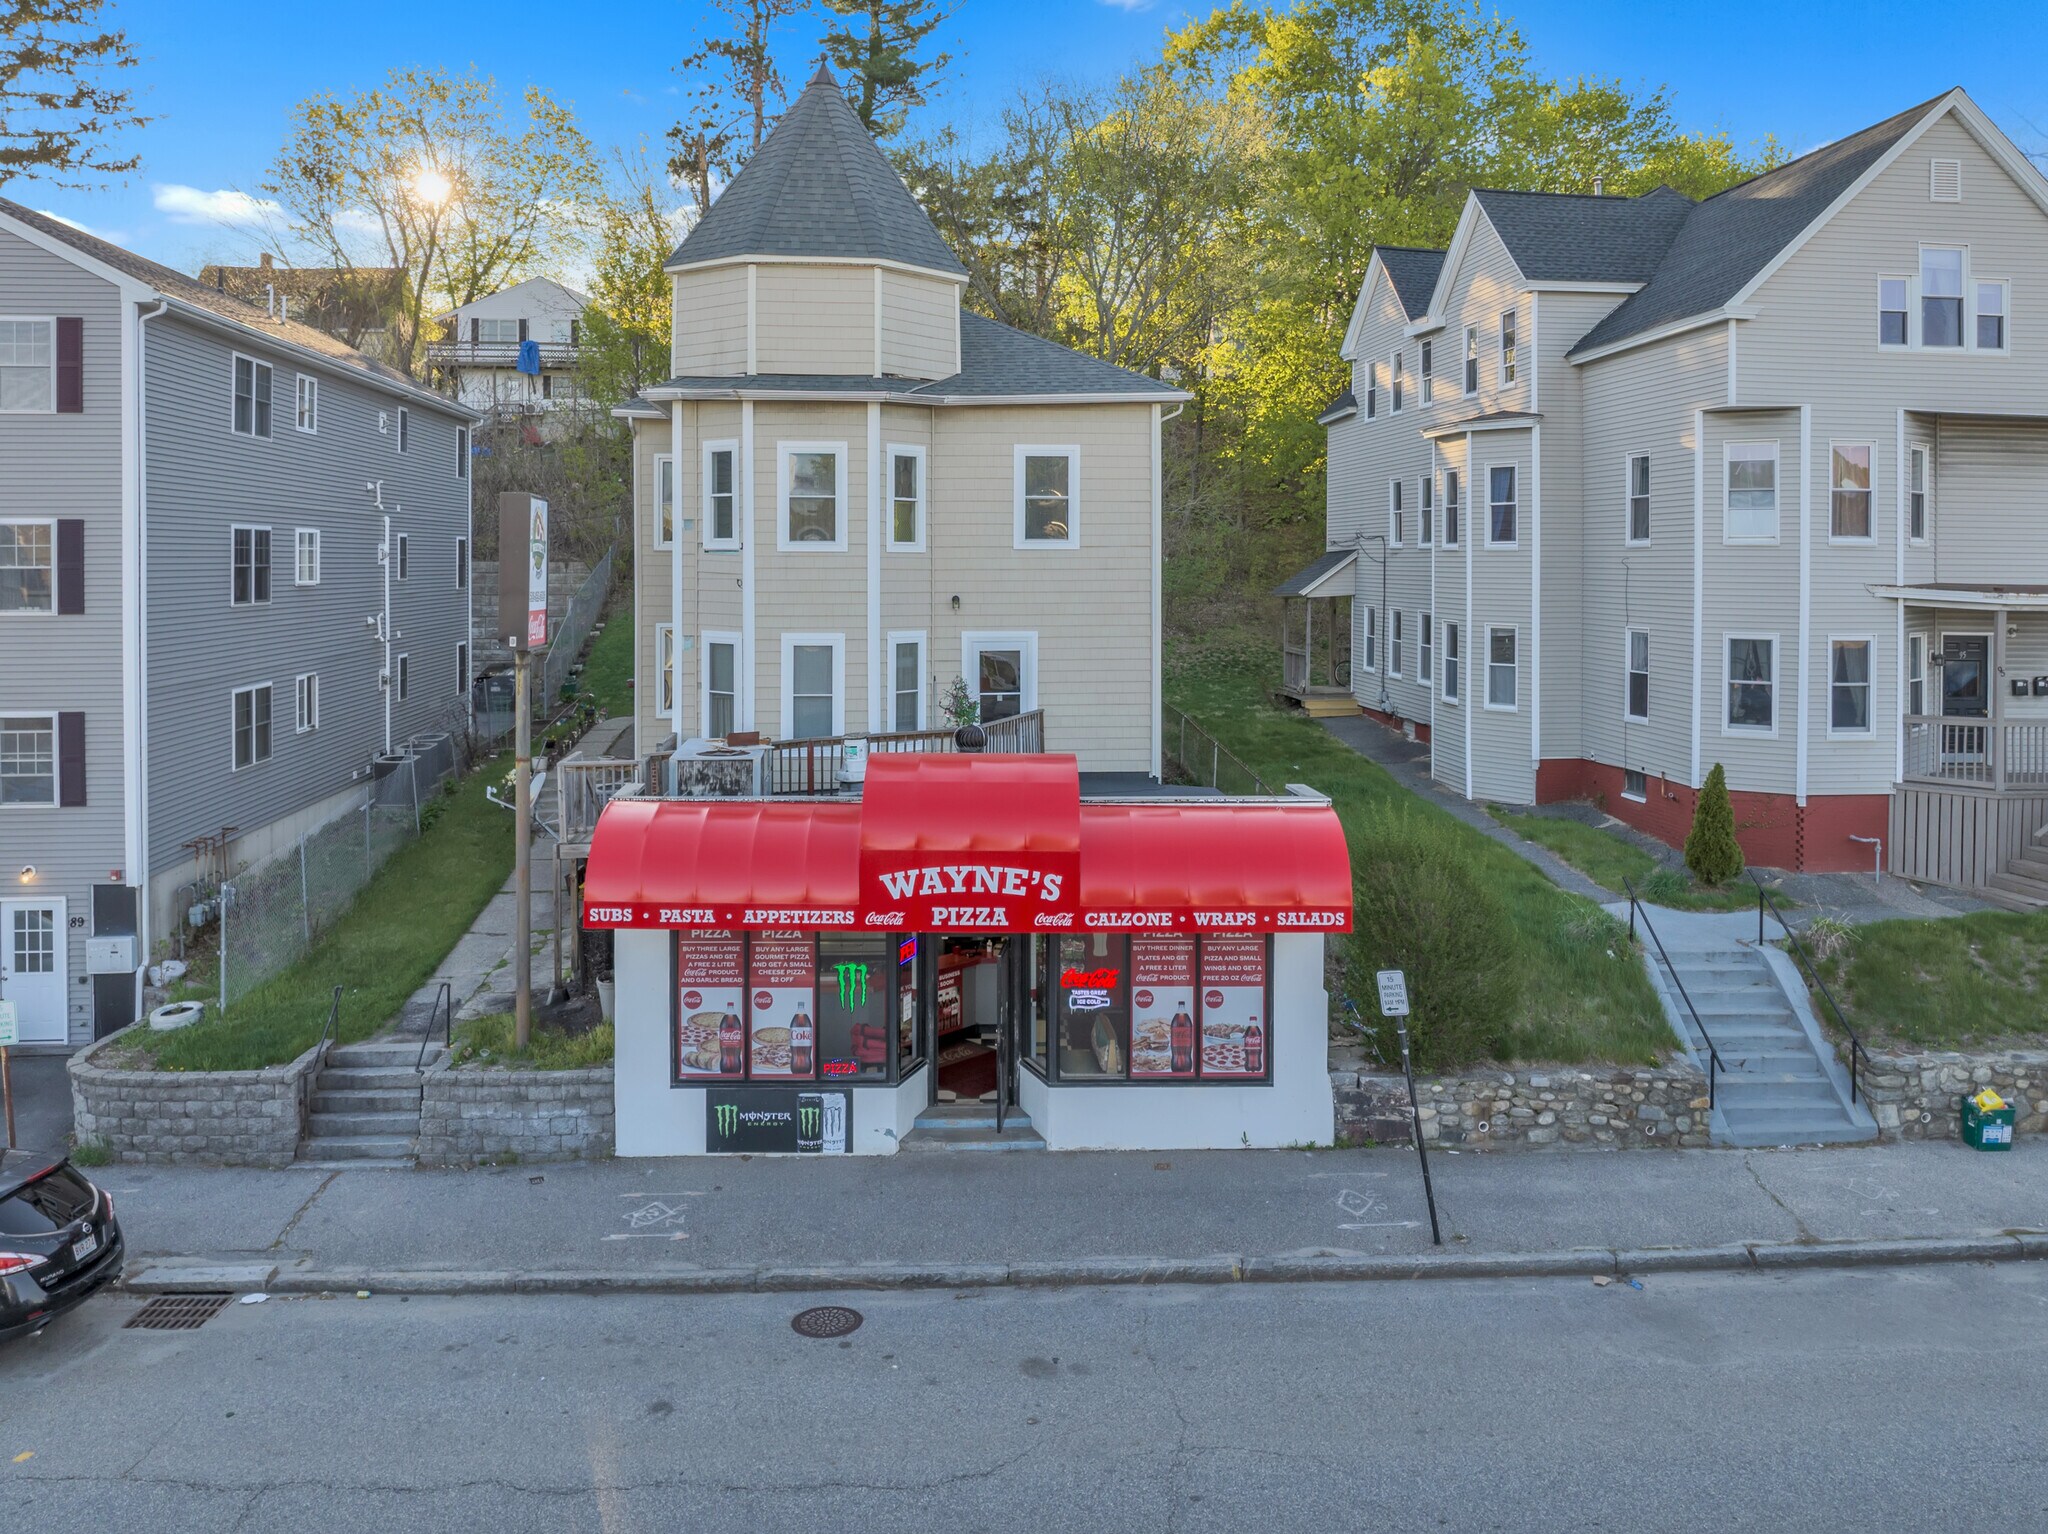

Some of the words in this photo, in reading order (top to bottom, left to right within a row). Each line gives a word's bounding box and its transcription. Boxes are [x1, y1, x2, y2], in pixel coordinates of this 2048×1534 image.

[1960, 650, 1967, 660] 95
[879, 866, 1062, 901] WAYNE'S
[70, 917, 84, 928] 89
[590, 908, 632, 922] SUBS
[660, 910, 716, 923] PASTA
[743, 910, 855, 924] APPETIZERS
[865, 912, 906, 926] Coca-Cola
[932, 907, 1009, 926] PIZZA
[1034, 912, 1074, 927] Coca-Cola
[1085, 912, 1172, 927] CALZONE
[1193, 912, 1256, 926] WRAPS
[1277, 912, 1345, 926] SALADS
[791, 1030, 812, 1040] Coke
[823, 1063, 856, 1074] PIZZA
[740, 1111, 791, 1122] MONSTER
